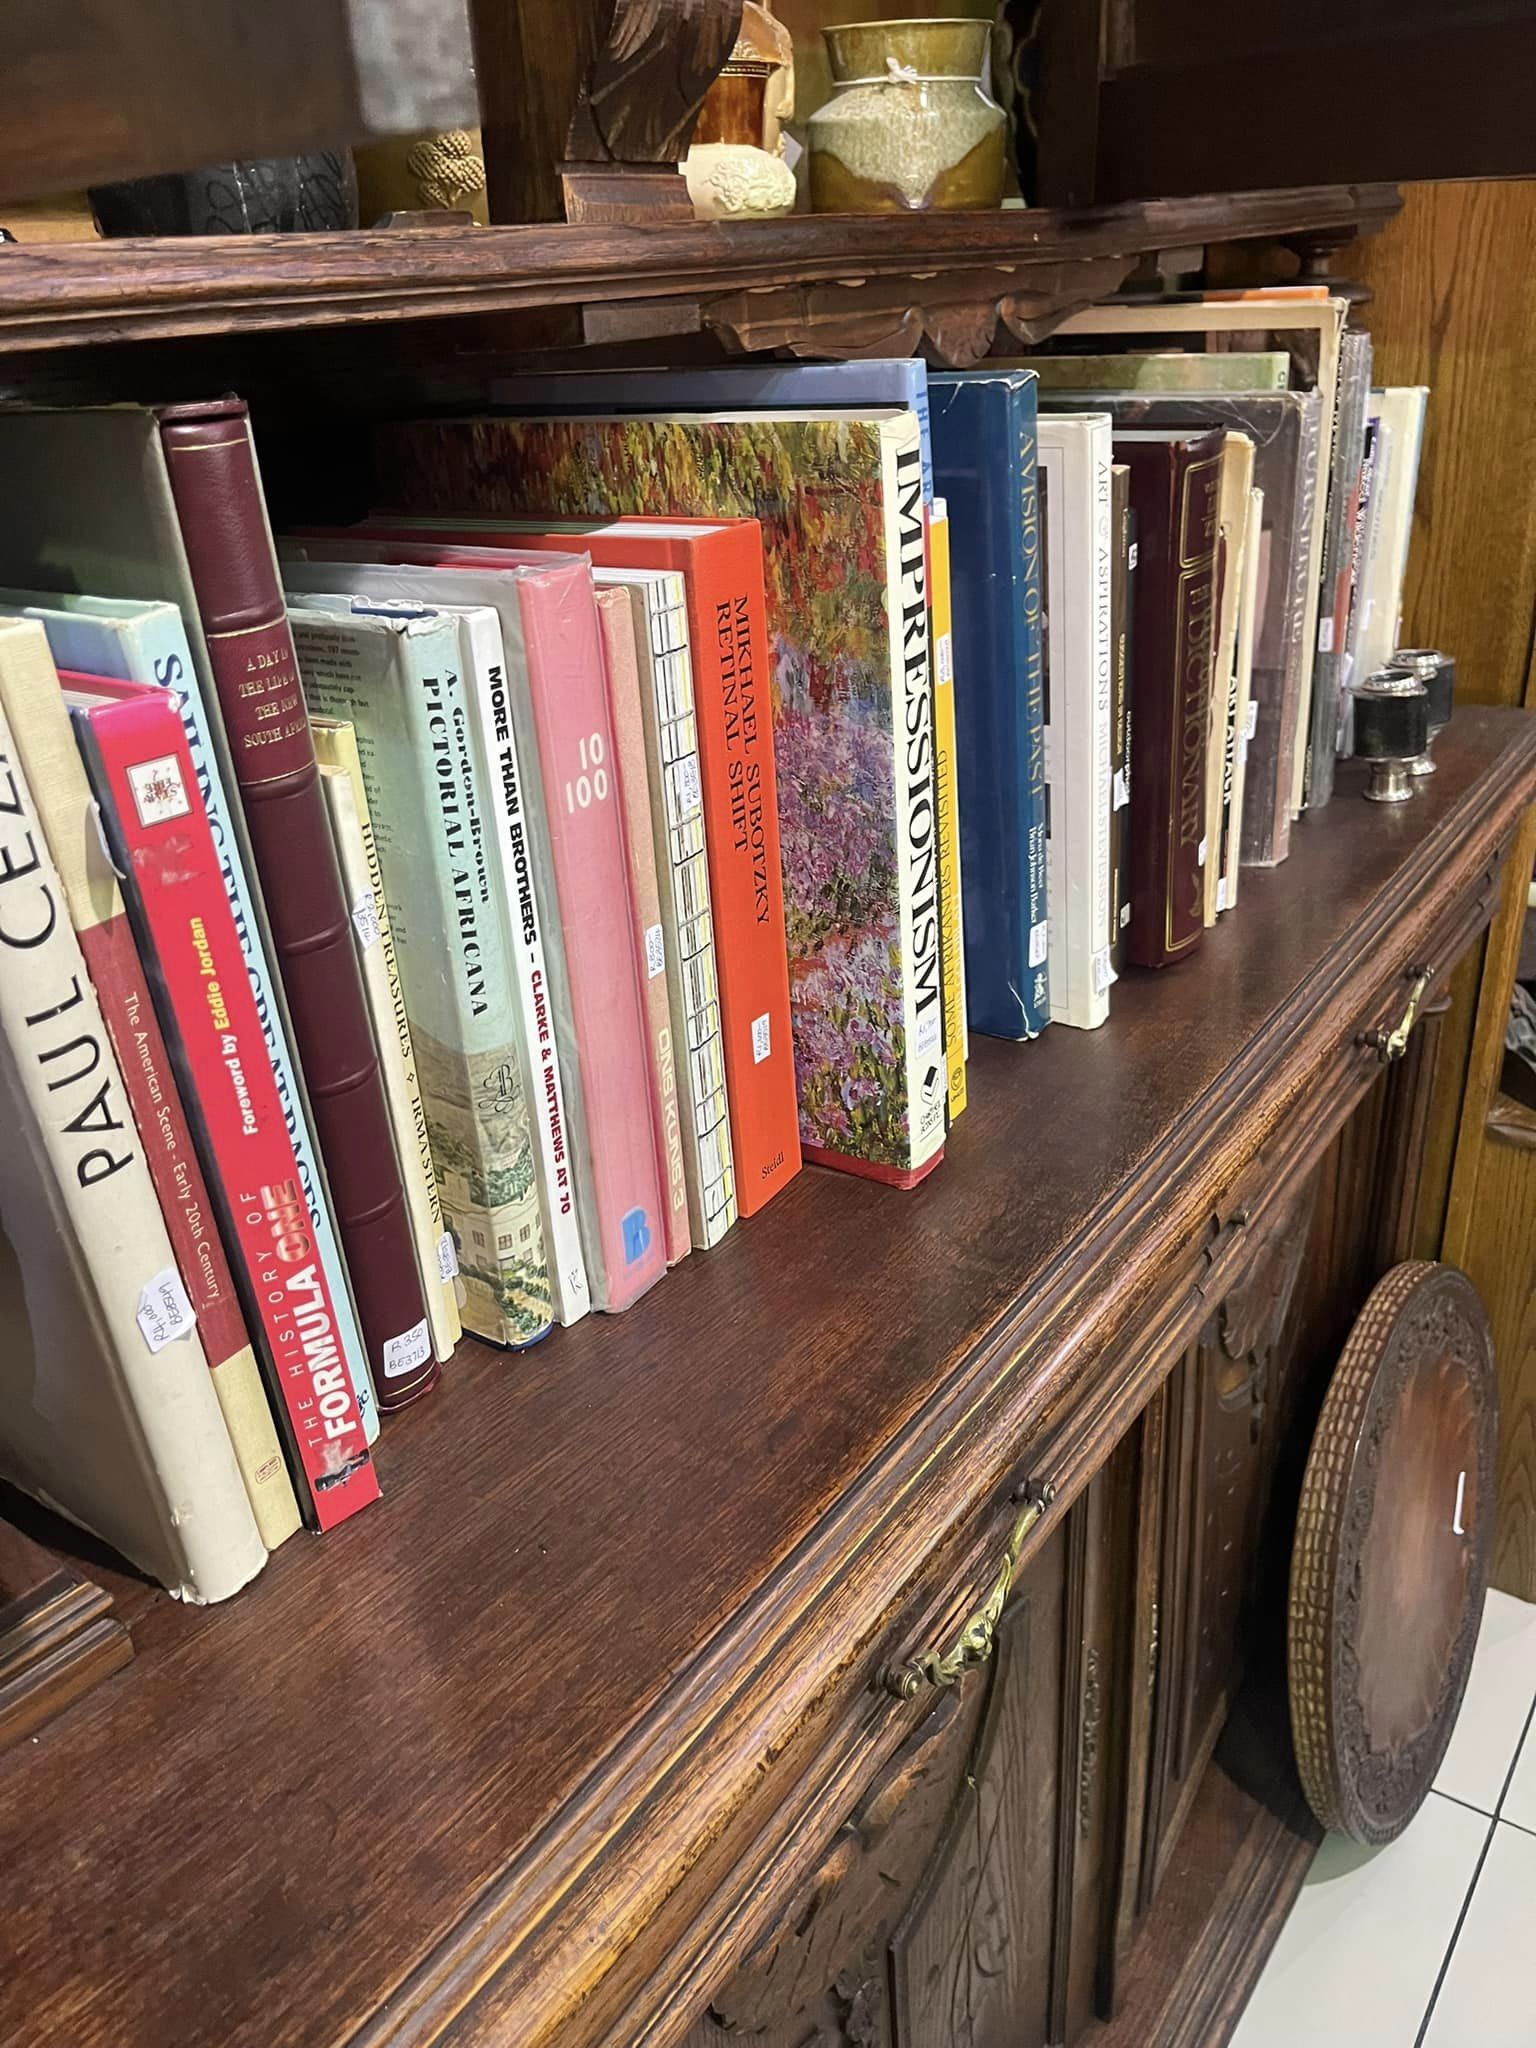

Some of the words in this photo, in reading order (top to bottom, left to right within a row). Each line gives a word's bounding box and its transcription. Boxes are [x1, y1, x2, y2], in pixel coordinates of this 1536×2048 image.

[1018, 430, 1035, 459] A
[1096, 461, 1107, 504] ART
[1020, 459, 1042, 583] VISION
[1023, 586, 1041, 631] OF
[1097, 547, 1108, 712] ASPIRATIONS
[239, 680, 265, 698] THE
[247, 657, 257, 672] A
[258, 649, 279, 669] DAY
[716, 600, 744, 752] RETINAL
[1024, 650, 1043, 720] THE
[244, 726, 284, 748] SOUTH
[255, 702, 280, 721] THE
[487, 666, 510, 742] MORE
[894, 449, 939, 1016] IMPRESSIONISM
[1178, 606, 1214, 848] DICTIONARY
[500, 746, 520, 816] THAN
[579, 732, 603, 769] 10
[731, 596, 758, 755] MIKHAEL
[746, 764, 770, 926] SUBOTZKY
[1026, 722, 1043, 797] PAST
[452, 707, 490, 904] Gordon-Brown
[565, 772, 609, 814] 100
[727, 760, 748, 852] SHIFT
[937, 750, 951, 860] REVISITED
[0, 754, 57, 950] CEZ
[422, 678, 465, 858] PICTORIAL
[452, 867, 489, 1018] AFRICANA
[509, 821, 538, 945] BROTHERS
[189, 916, 216, 977] Jordan
[939, 864, 956, 987] AFRIKANERS
[204, 980, 231, 1032] Eddie
[361, 822, 386, 921] HIDDEN
[379, 926, 414, 1059] TREASURES
[410, 1095, 430, 1149] IRMA
[420, 1150, 443, 1224] STERN
[530, 969, 550, 1043] CLARKE
[944, 995, 958, 1048] SOME
[24, 975, 135, 1189] PAUL
[220, 1033, 239, 1058] by
[541, 1047, 552, 1062] &
[659, 1027, 674, 1096] ONS
[229, 1056, 258, 1136] Foreword
[543, 1066, 566, 1164] MATTHEWS
[124, 991, 141, 1027] The
[134, 1031, 166, 1104] American
[156, 1103, 177, 1153] Scene
[173, 1161, 192, 1202] Early
[185, 1201, 205, 1236] 20th
[197, 1237, 221, 1299] Century
[556, 1166, 570, 1189] AT
[664, 1099, 683, 1186] KUNS
[760, 1153, 786, 1180] Steidl
[240, 1192, 263, 1225] OF
[260, 1178, 314, 1262] ONE
[560, 1192, 573, 1216] 70
[674, 1187, 684, 1211] 3
[256, 1250, 305, 1377] HISTORY
[284, 1262, 359, 1441] FORMULA
[298, 1395, 320, 1447] THE
